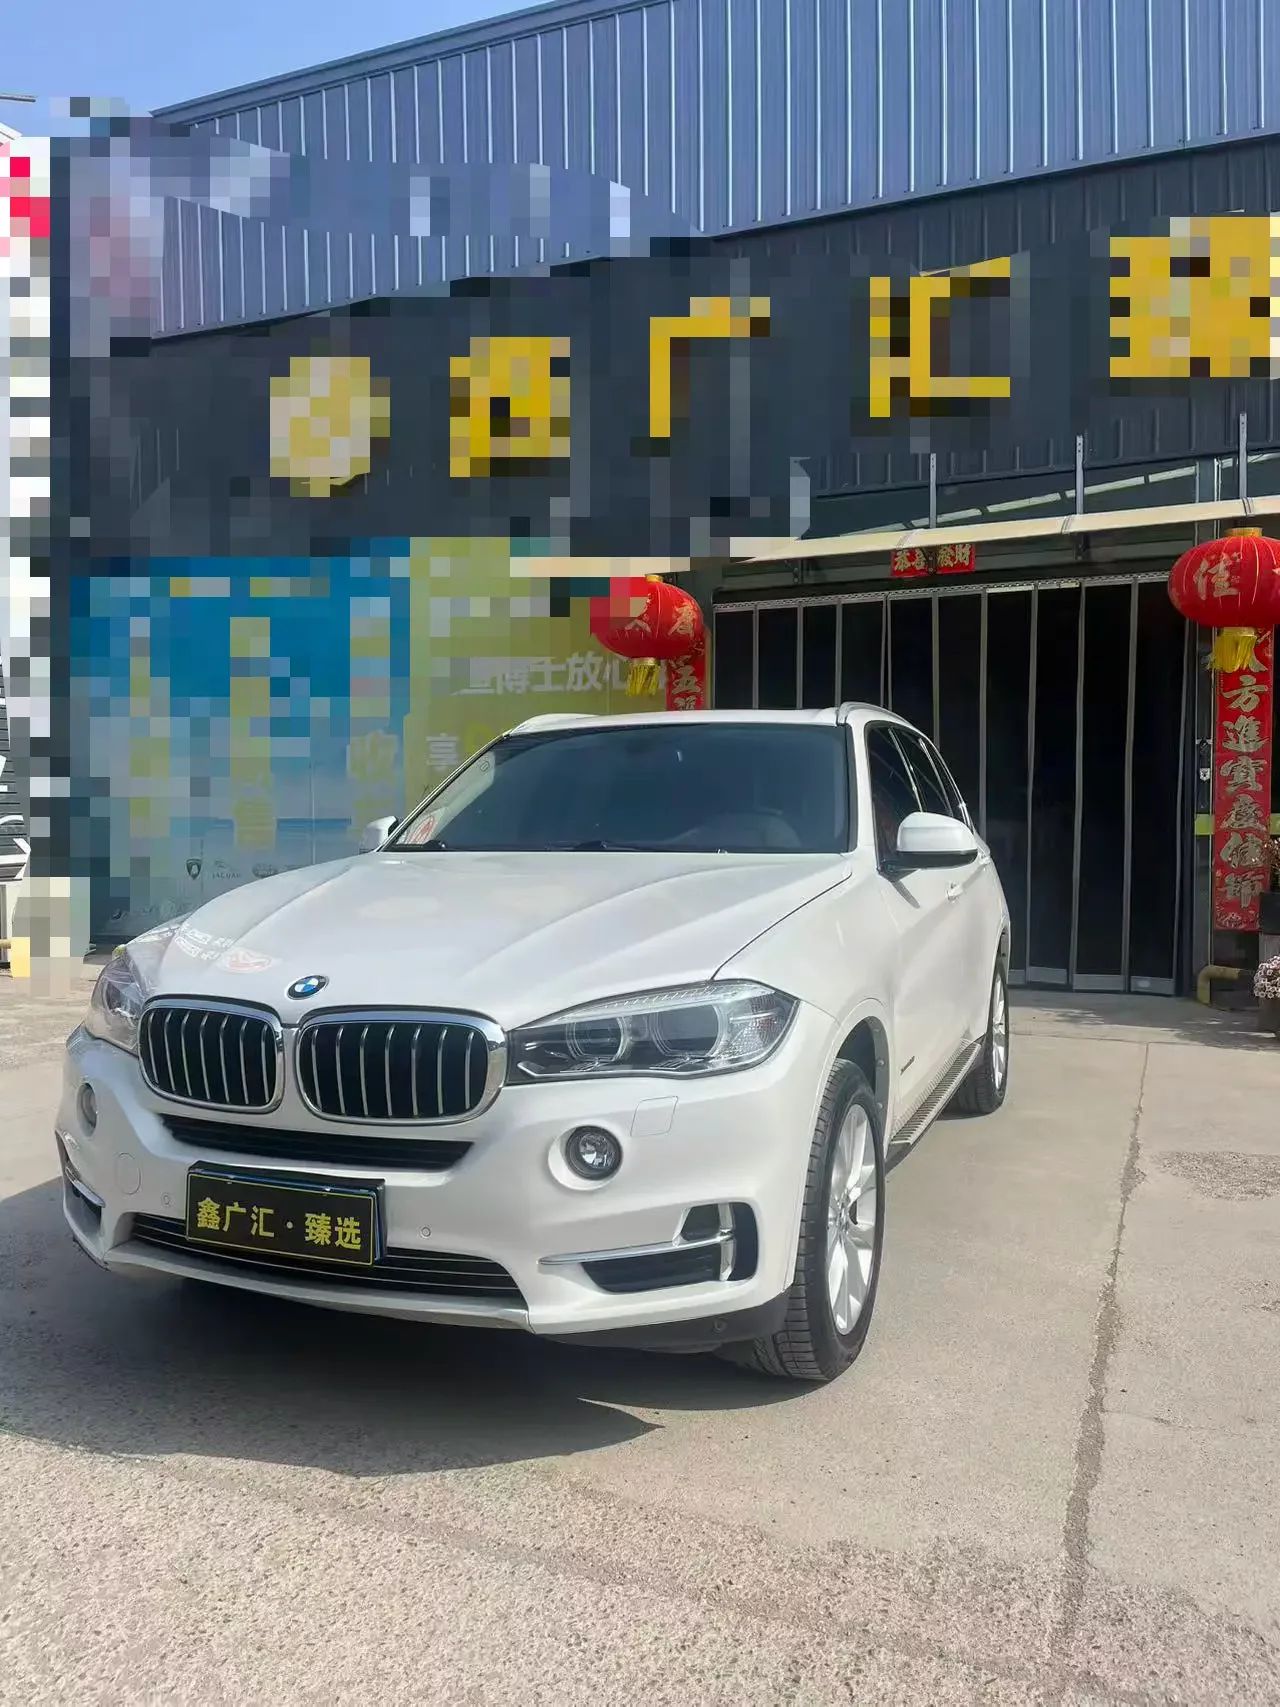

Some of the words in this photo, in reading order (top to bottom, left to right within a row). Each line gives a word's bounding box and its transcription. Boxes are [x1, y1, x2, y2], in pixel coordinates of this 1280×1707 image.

[197, 1197, 361, 1250] 鑫广汇·臻选
